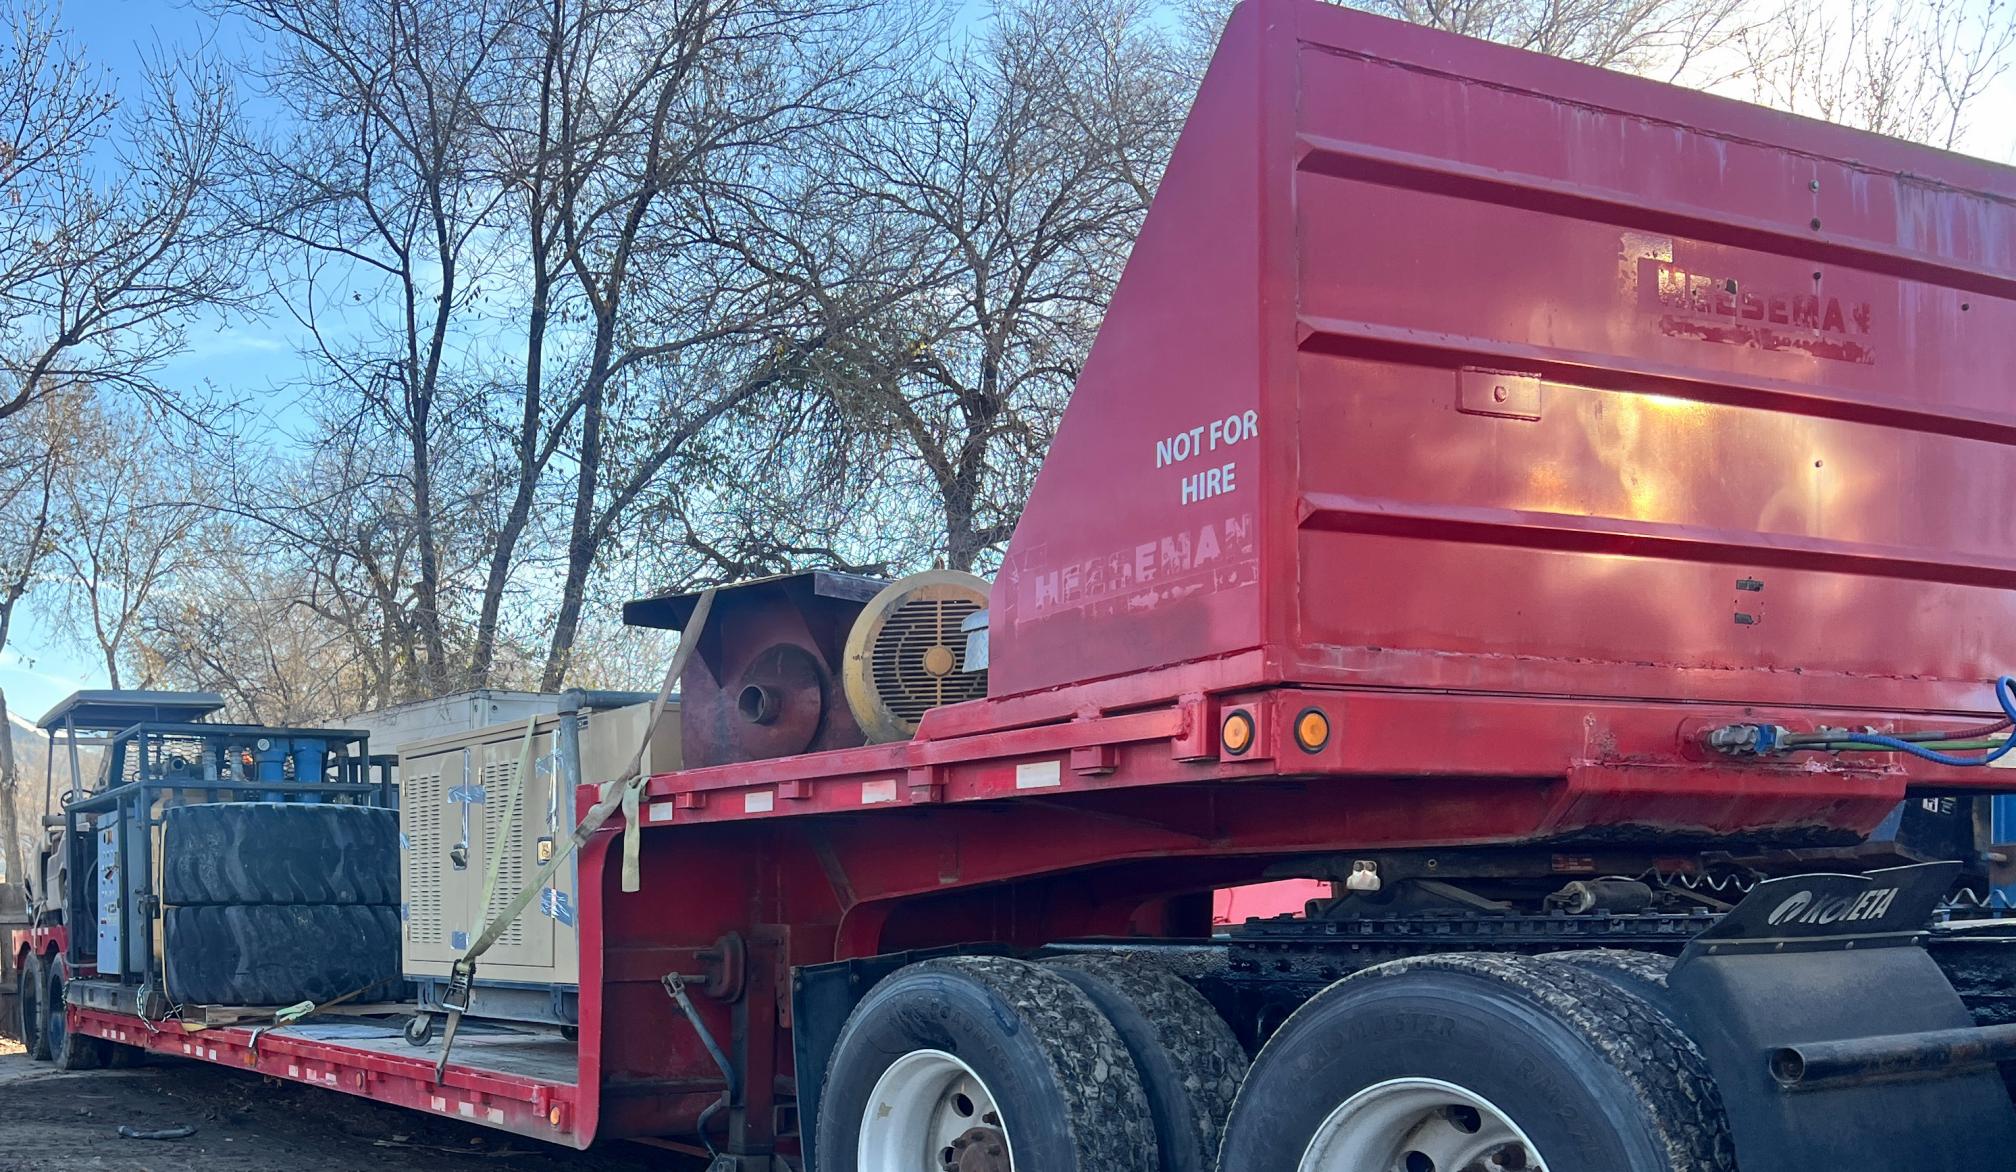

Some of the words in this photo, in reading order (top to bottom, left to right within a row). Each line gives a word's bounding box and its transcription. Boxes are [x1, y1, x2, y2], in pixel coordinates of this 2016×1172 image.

[1156, 426, 1204, 468] NOT
[1209, 409, 1258, 451] FOR
[1181, 462, 1236, 505] HIRE
